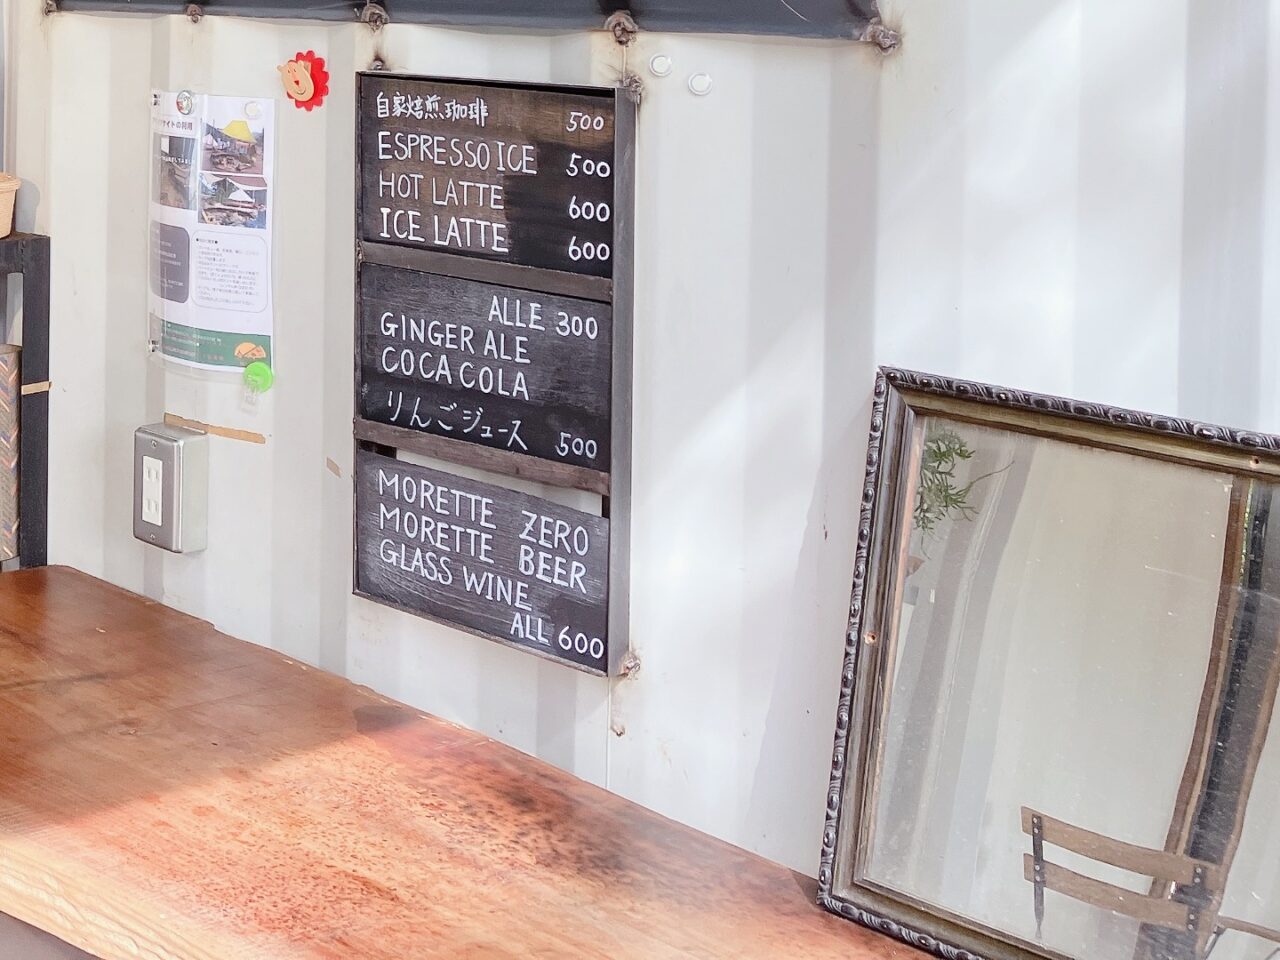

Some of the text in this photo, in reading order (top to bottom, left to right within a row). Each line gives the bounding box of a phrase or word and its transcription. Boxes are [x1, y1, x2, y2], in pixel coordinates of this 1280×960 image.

[376, 91, 604, 132] 自家焙煎珈琲 500
[378, 131, 611, 178] ESPRESSO ICE 500
[379, 173, 610, 222] HOT LATTE 600
[380, 207, 610, 261] ICE LATTE 600
[380, 312, 531, 363] GINGER ALE
[488, 295, 598, 340] ALLE 300
[382, 346, 530, 400] COCA COLA
[387, 390, 598, 459] りんごジュース 500
[379, 469, 589, 556] MORETTE ZERO
[380, 503, 587, 593] MORETTE BEER
[380, 539, 532, 611] GLASS WINE
[510, 612, 604, 659] ALL 600
